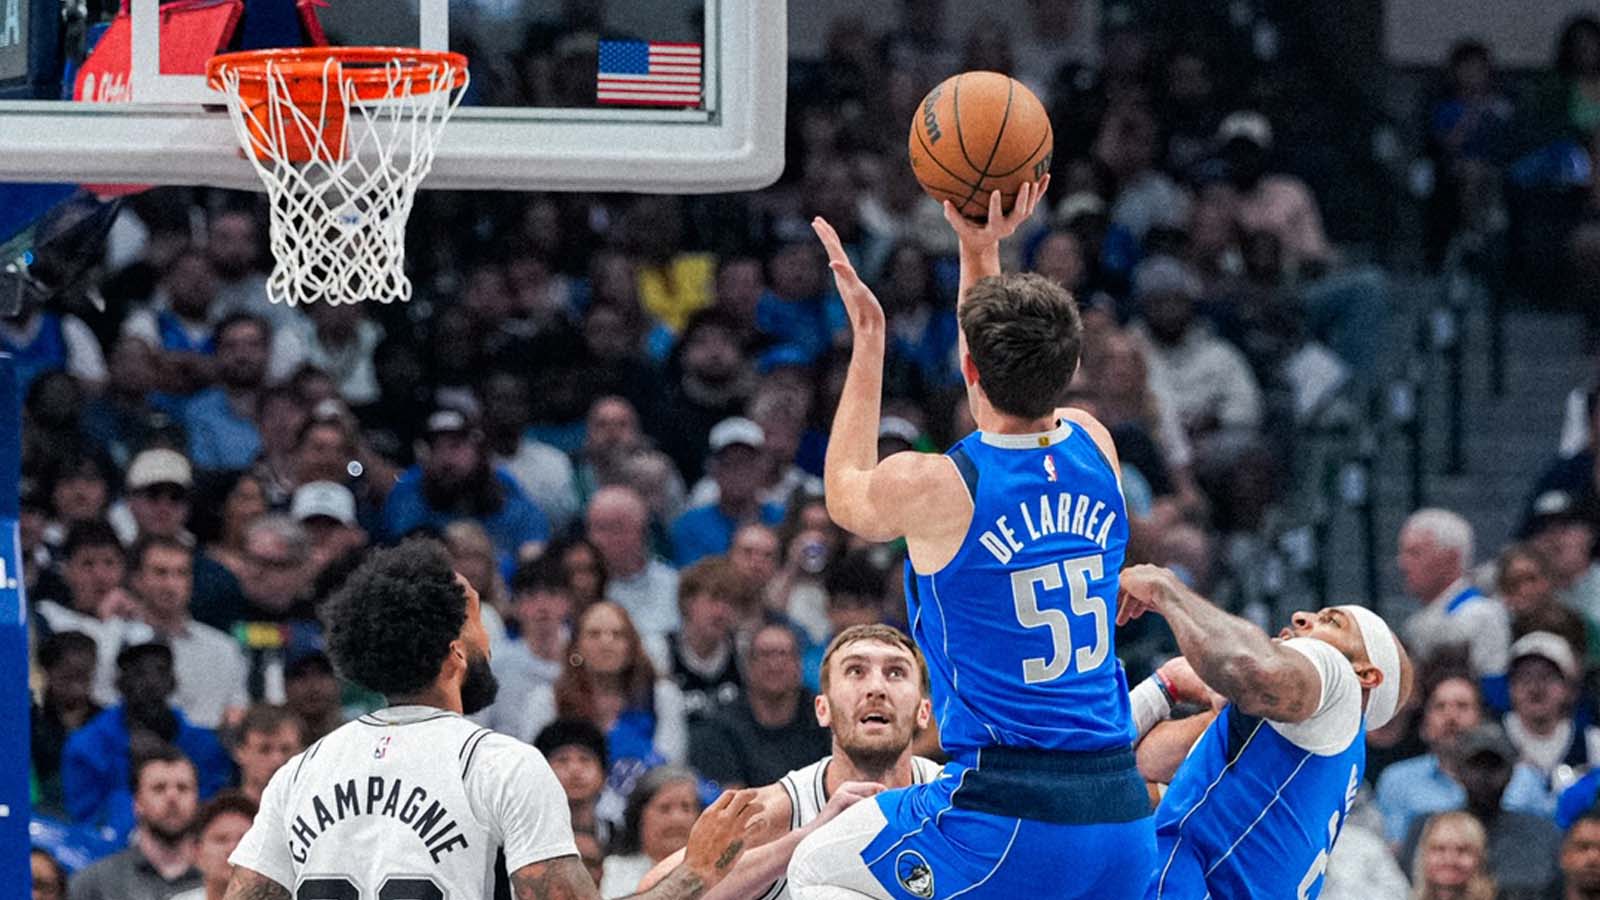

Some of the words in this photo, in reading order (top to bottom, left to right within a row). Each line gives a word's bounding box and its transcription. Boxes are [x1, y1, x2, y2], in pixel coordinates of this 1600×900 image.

[979, 515, 1024, 564] DE
[1020, 492, 1116, 549] LARREA
[1010, 554, 1109, 684] 55
[289, 776, 469, 864] CHAMPAGNIE
